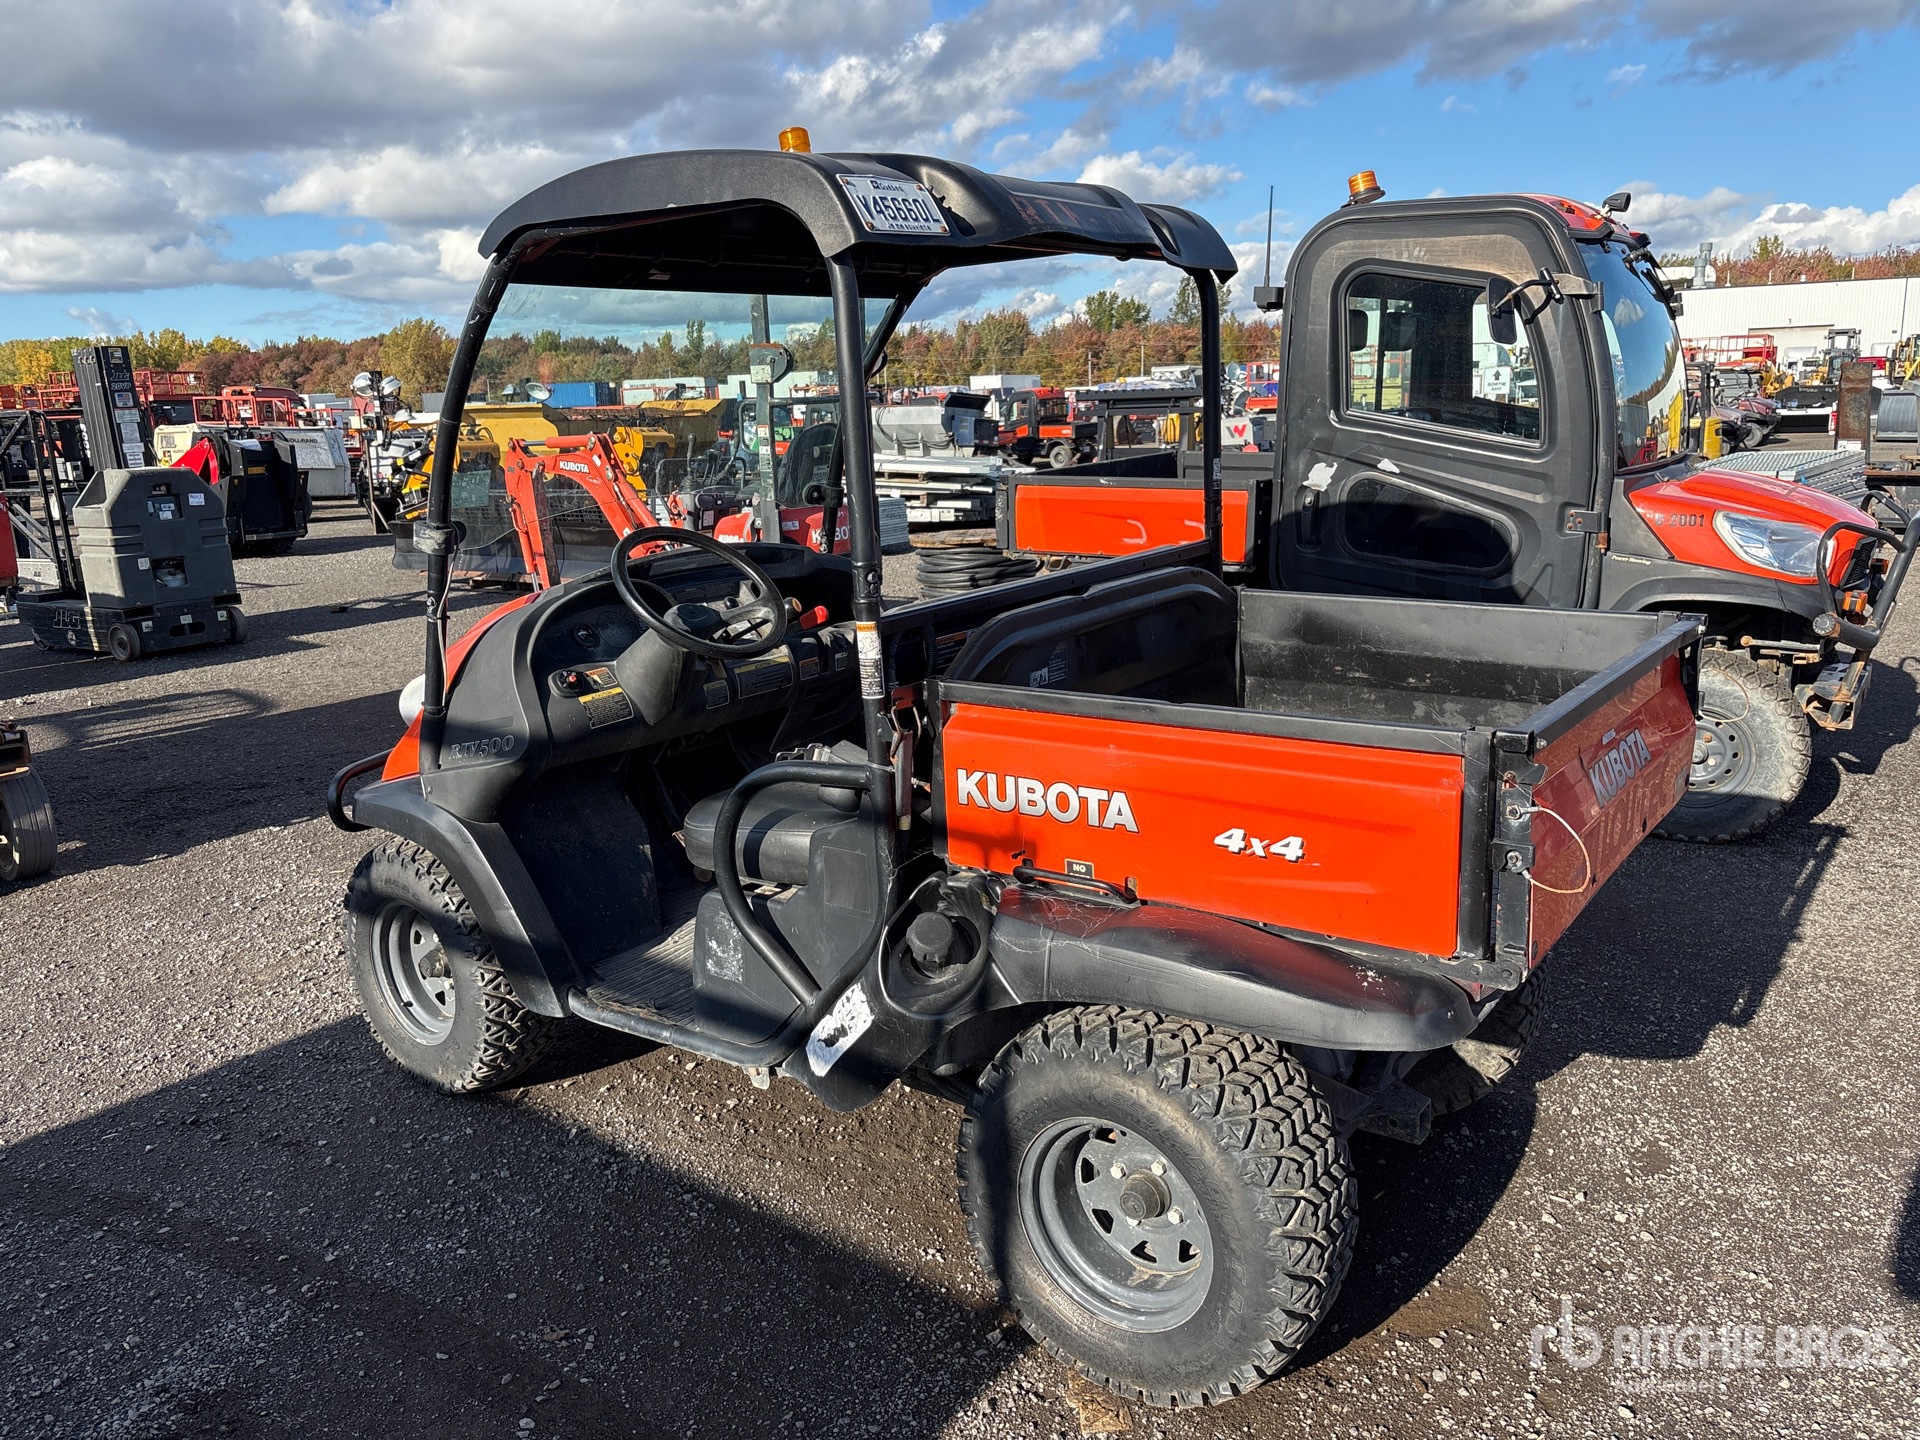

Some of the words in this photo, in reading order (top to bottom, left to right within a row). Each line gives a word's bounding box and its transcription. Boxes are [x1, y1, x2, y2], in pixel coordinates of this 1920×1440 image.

[111, 382, 132, 391] 20VP
[559, 460, 590, 474] KUBOTA
[1629, 556, 1652, 566] Steering
[448, 734, 515, 760] RTV500
[1587, 727, 1653, 809] KUBOTA
[956, 768, 1139, 833] KUBOTA
[1213, 827, 1306, 862] 4x4
[1072, 863, 1086, 873] NO
